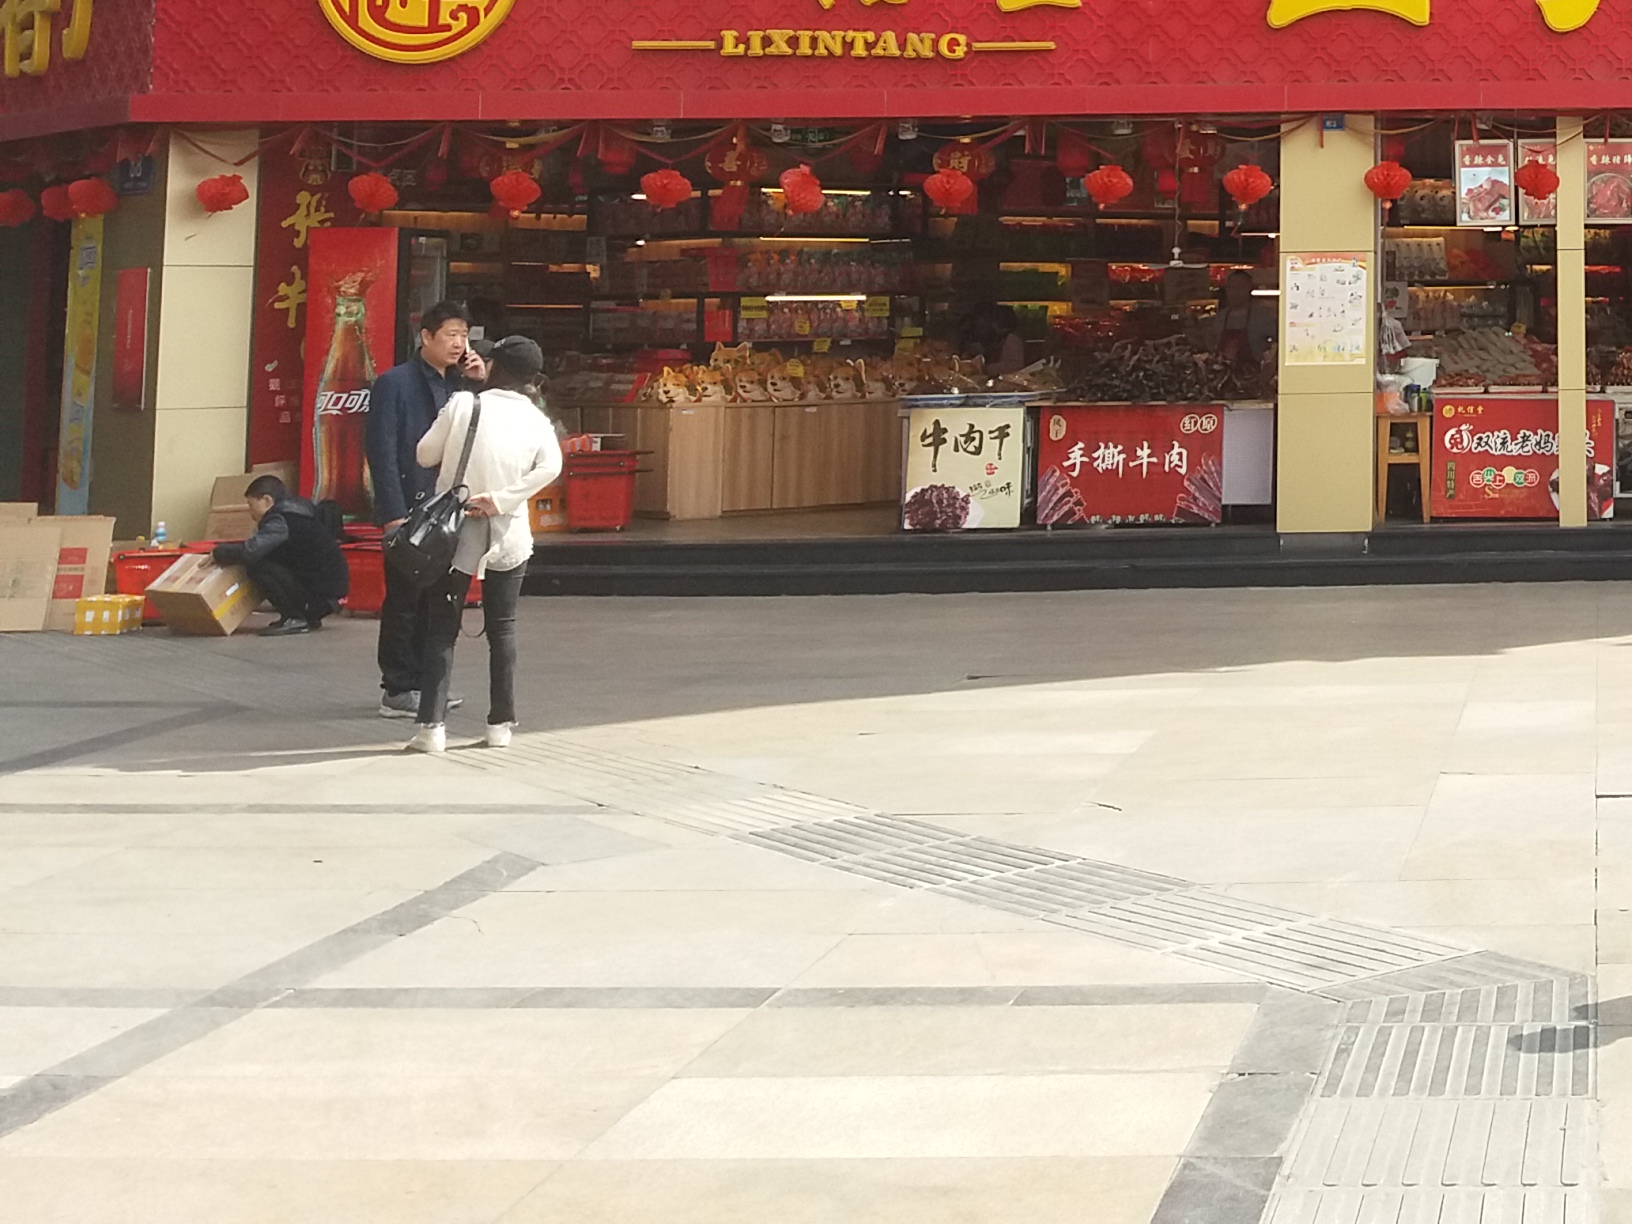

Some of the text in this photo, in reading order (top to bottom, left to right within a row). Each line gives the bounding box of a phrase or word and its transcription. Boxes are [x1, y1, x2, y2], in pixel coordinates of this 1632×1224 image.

[720, 30, 967, 60] LIXINTANG
[919, 418, 1012, 473] 牛肉干
[1062, 440, 1188, 479] 手撕牛肉
[1472, 429, 1595, 457] 双流老妈
